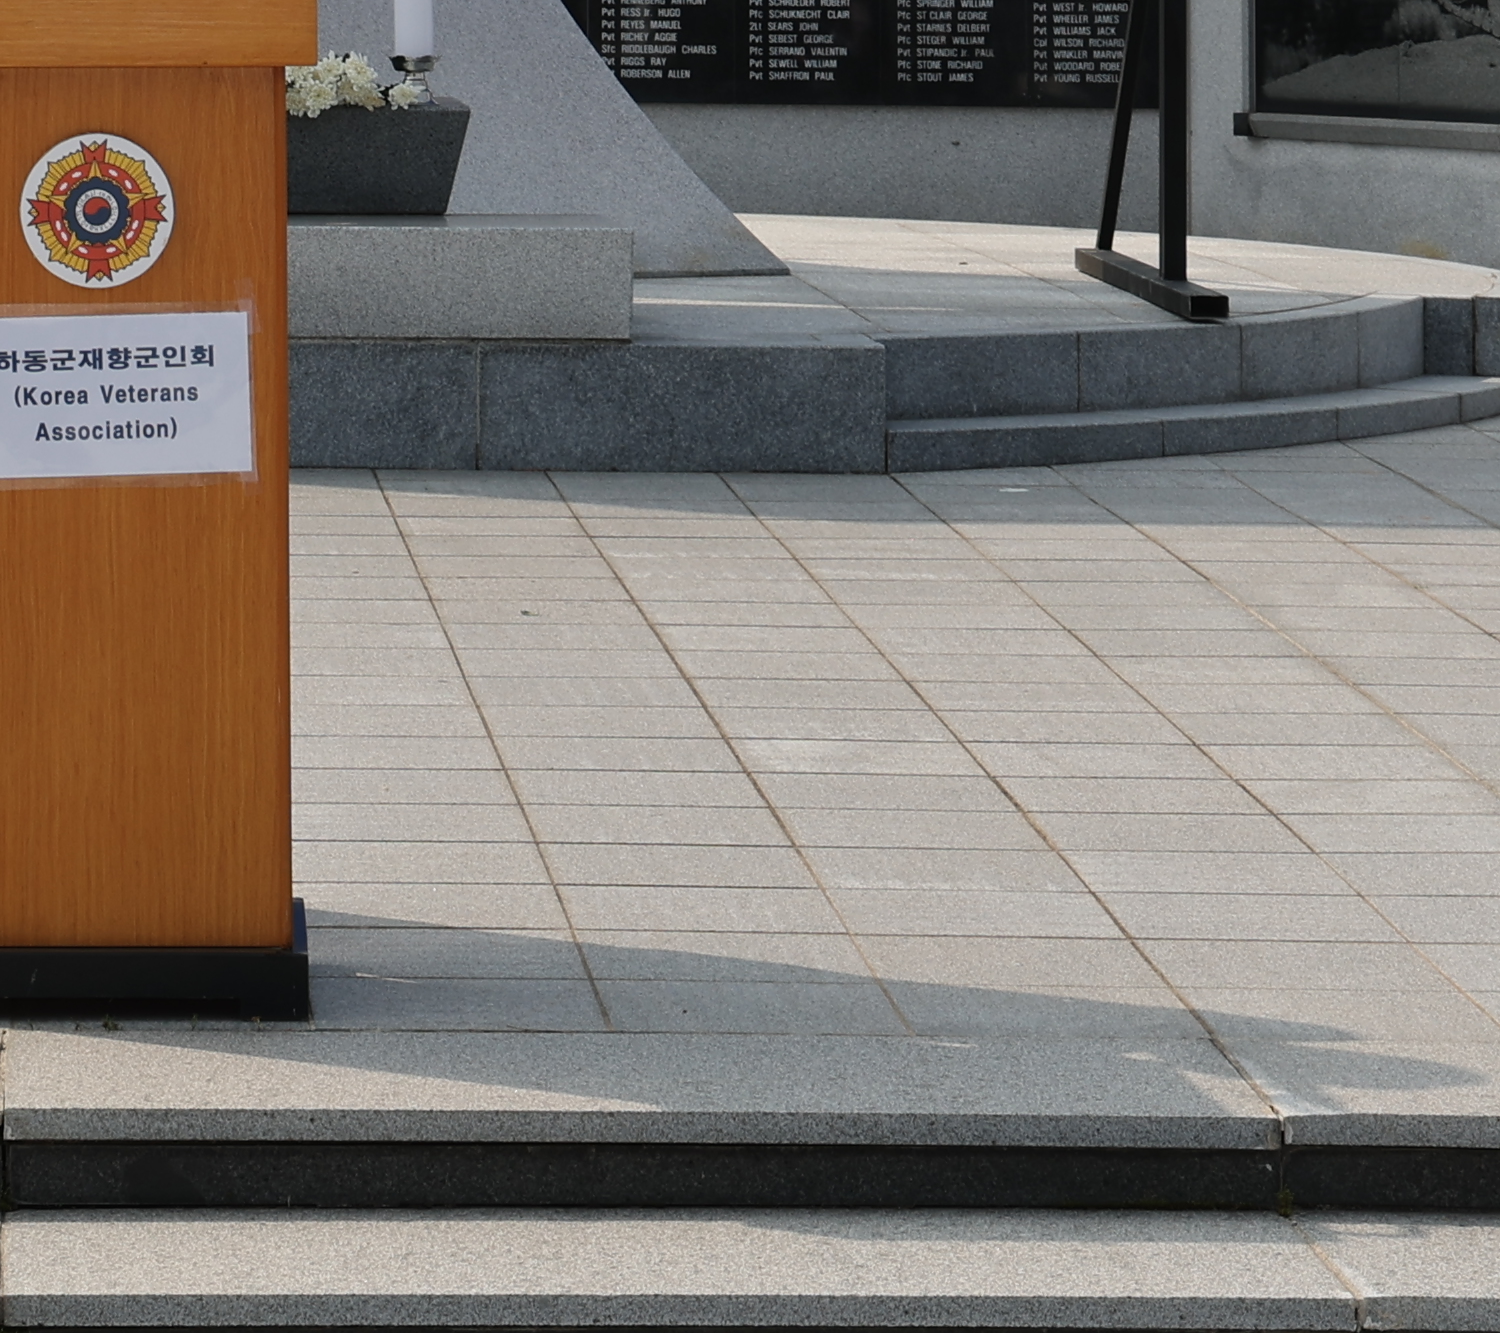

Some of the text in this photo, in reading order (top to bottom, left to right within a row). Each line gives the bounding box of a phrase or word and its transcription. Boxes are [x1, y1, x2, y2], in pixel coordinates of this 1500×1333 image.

[14, 385, 199, 407] (Korea Veterans
[35, 417, 178, 441] Association)
